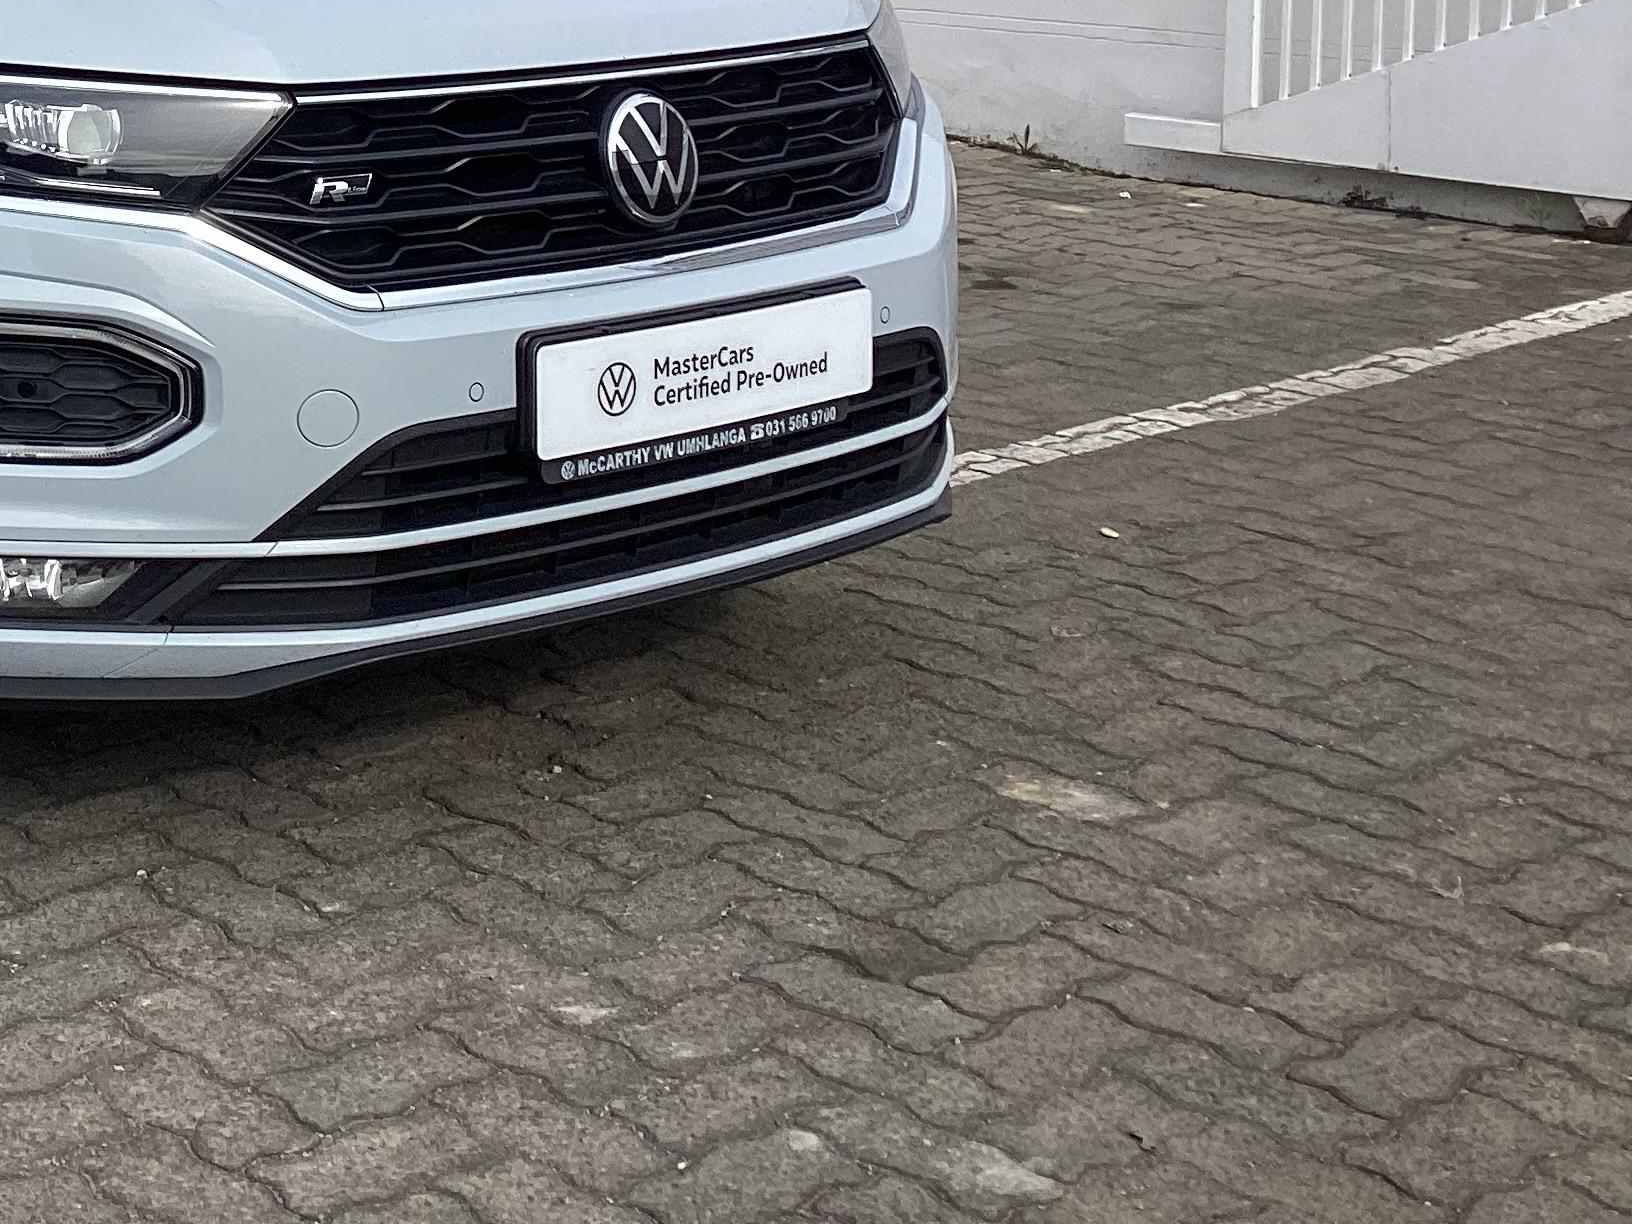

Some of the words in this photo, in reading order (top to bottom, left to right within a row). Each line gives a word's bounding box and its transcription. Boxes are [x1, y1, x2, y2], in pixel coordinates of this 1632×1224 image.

[654, 345, 754, 380] MasterCars
[654, 371, 731, 407] Certified
[737, 351, 828, 391] Pre-Owned
[577, 447, 651, 477] McCARTHY
[653, 442, 674, 461] VW
[677, 427, 746, 456] UMHLANGA
[765, 419, 786, 437] 031
[788, 412, 809, 432] 566
[811, 406, 837, 426] 9700
